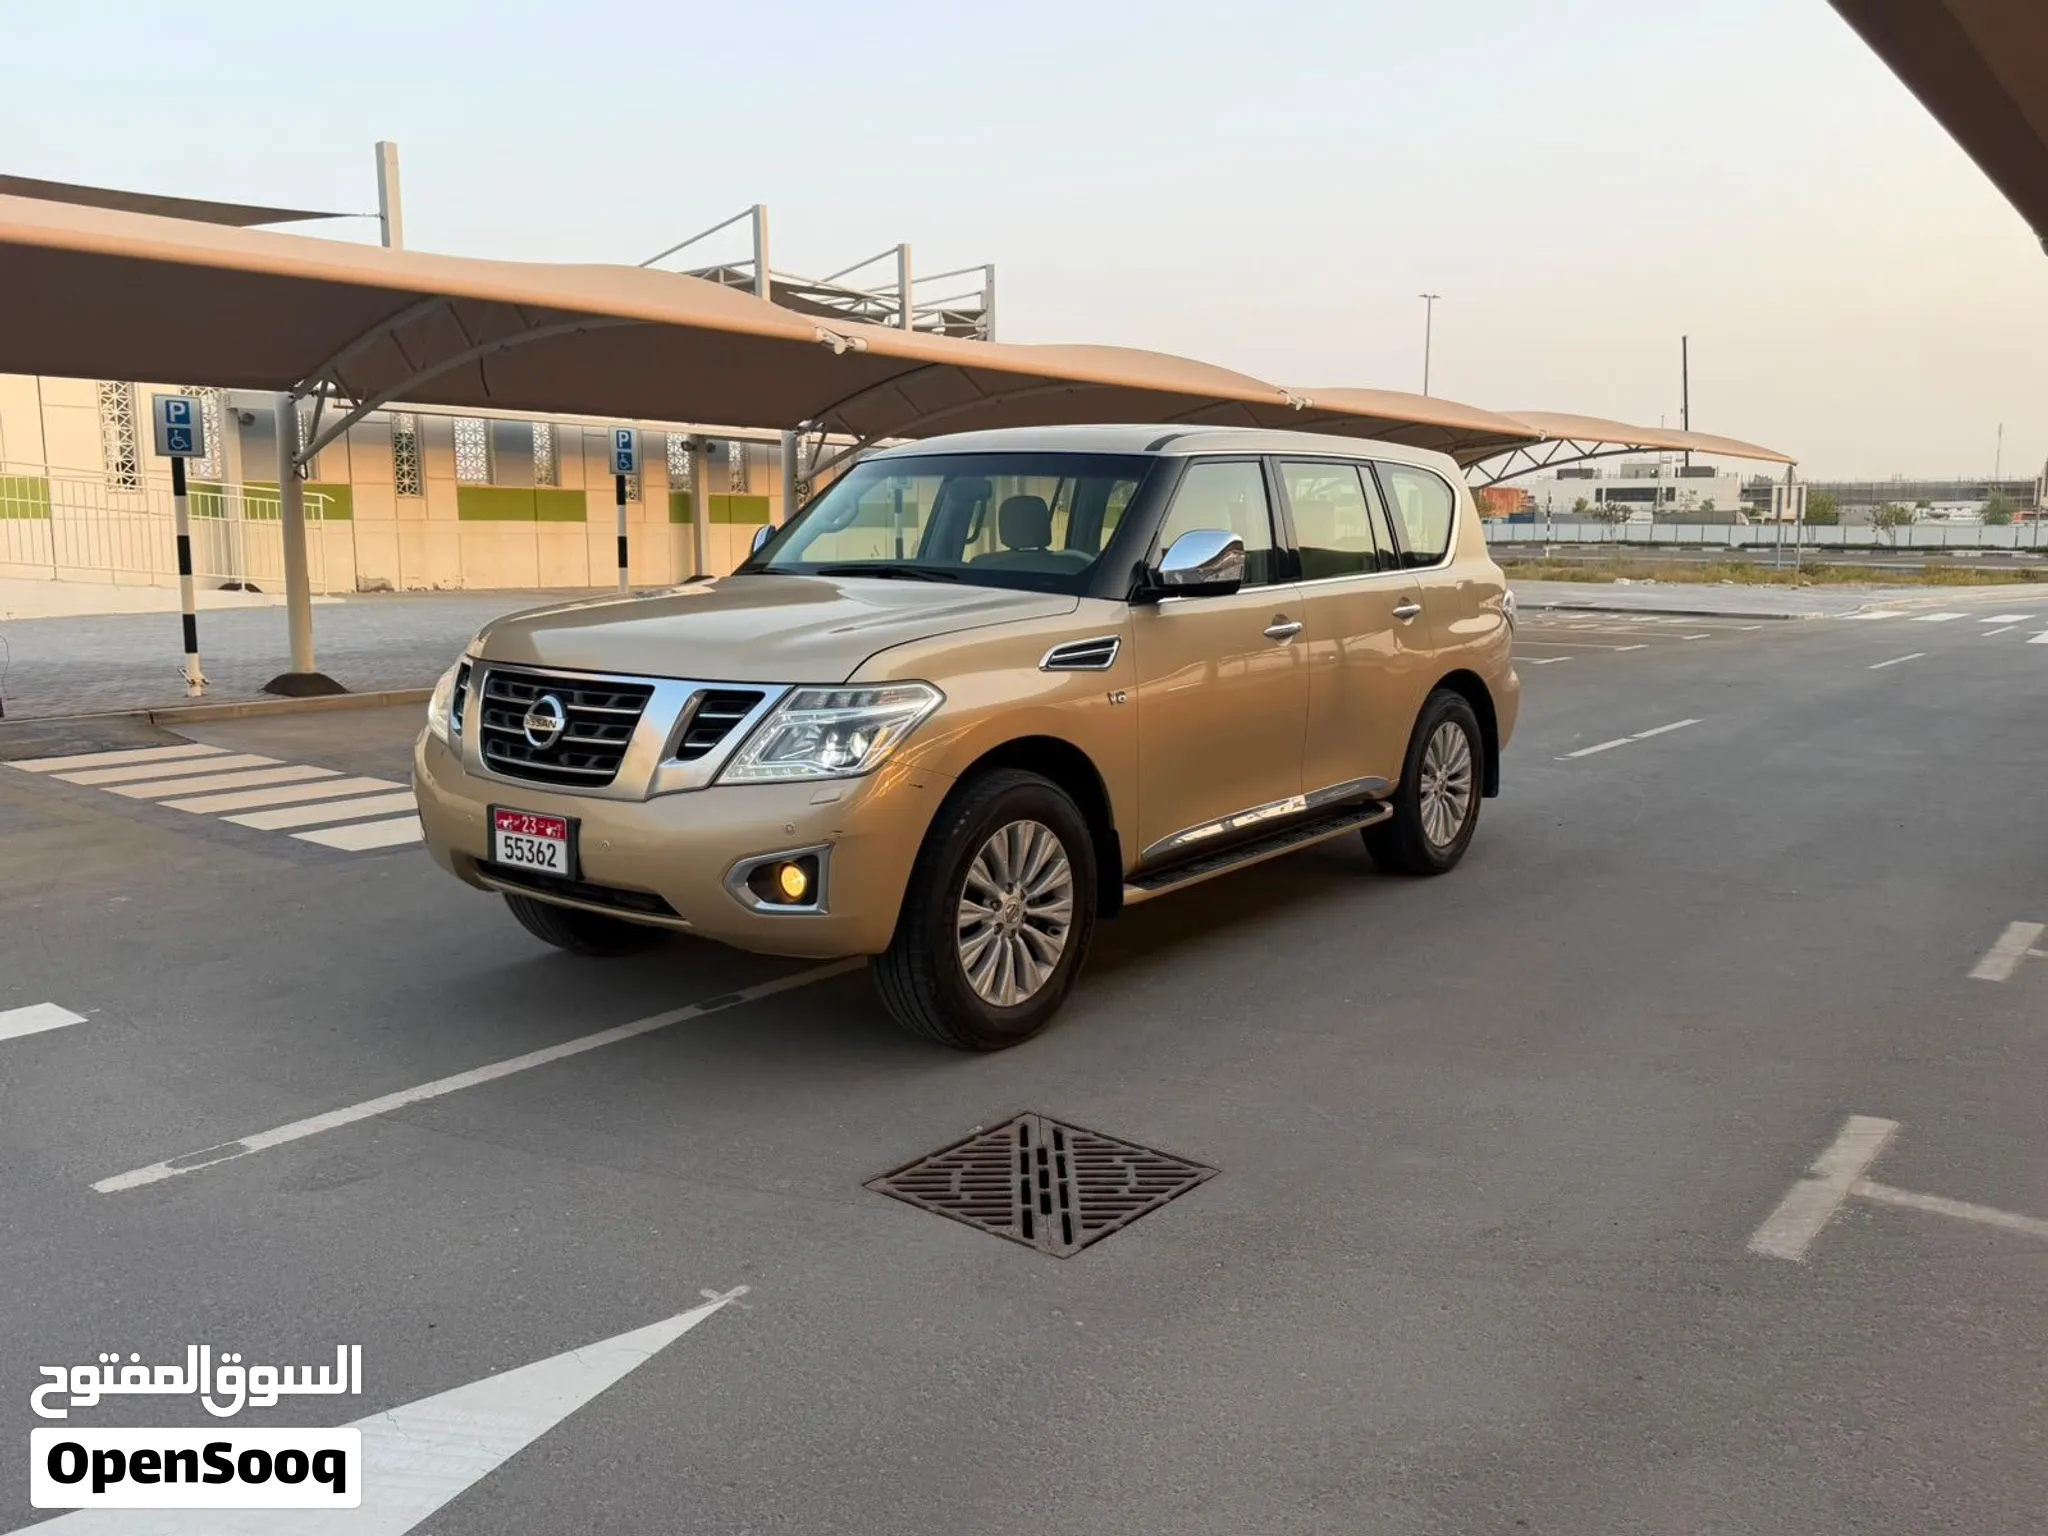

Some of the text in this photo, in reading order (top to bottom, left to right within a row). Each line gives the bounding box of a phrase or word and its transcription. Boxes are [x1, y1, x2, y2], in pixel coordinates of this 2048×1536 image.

[168, 401, 186, 422] P
[618, 431, 630, 448] P
[521, 816, 537, 834] 23
[504, 835, 557, 868] 55362
